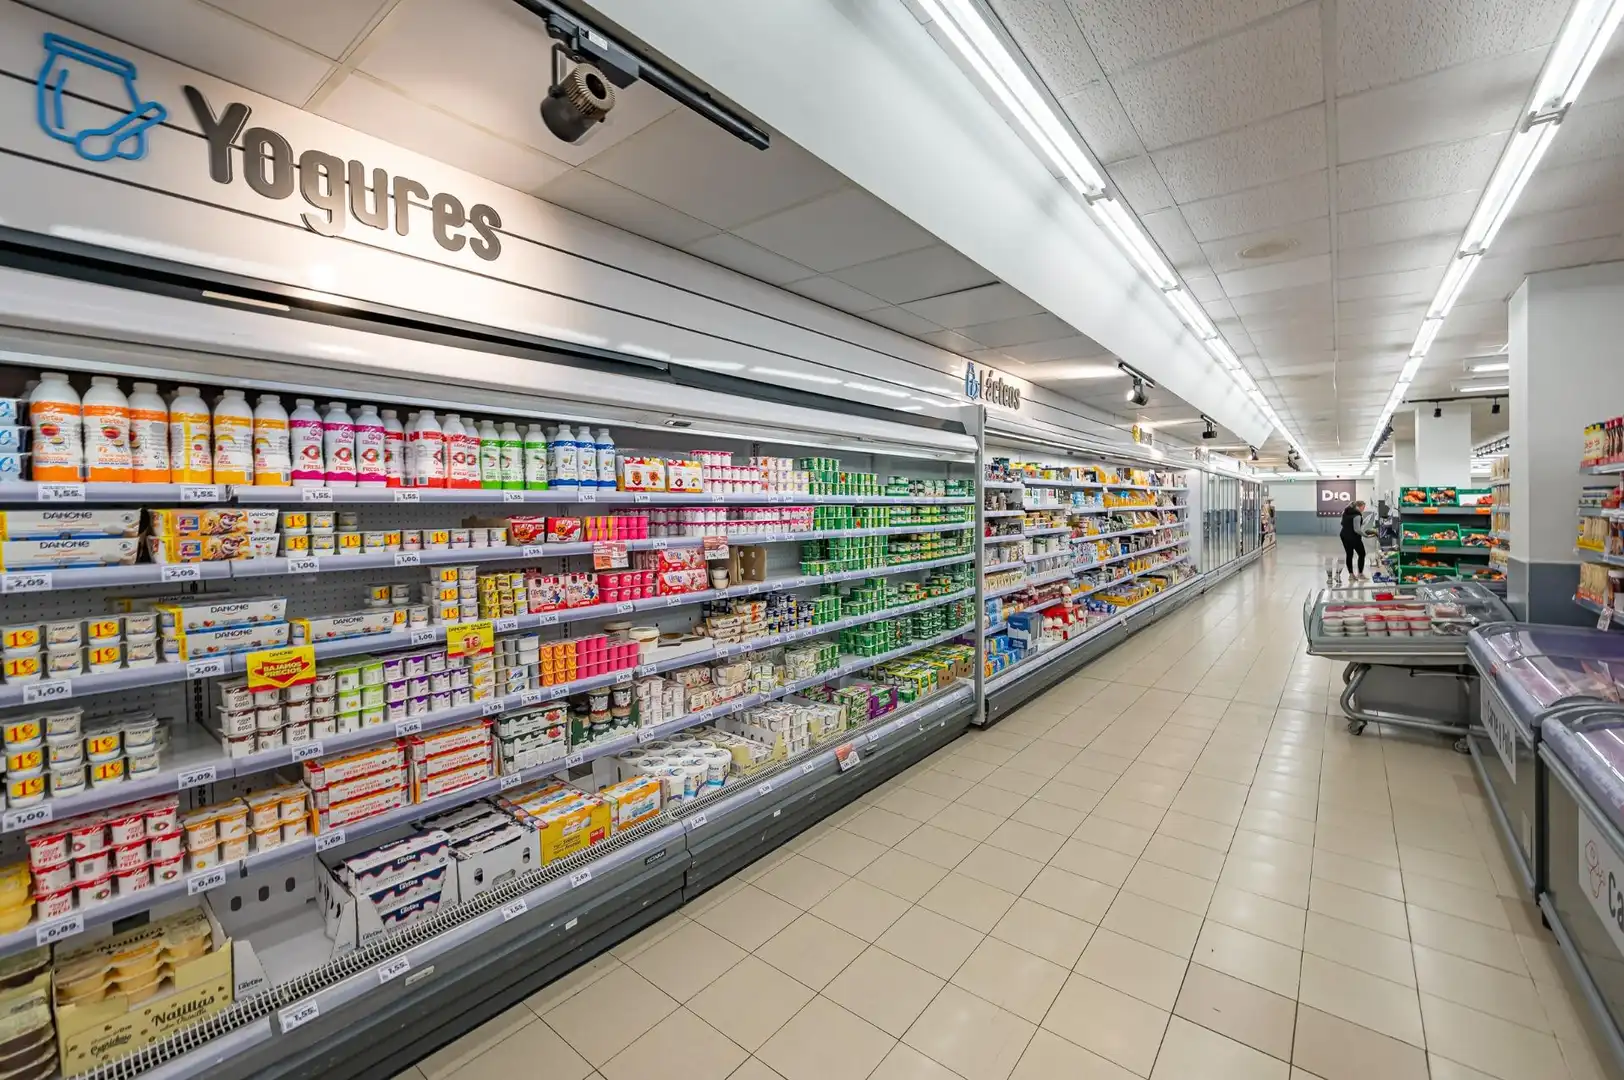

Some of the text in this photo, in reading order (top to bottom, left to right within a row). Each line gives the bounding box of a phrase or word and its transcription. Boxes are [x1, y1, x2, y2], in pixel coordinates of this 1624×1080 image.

[183, 84, 502, 261] Yogures
[980, 370, 1020, 410] Lácteos
[43, 511, 92, 520] DANONE
[39, 541, 90, 550] DANONE
[210, 603, 249, 614] DANONE
[333, 616, 364, 626] DANONE
[215, 629, 253, 640] DANONE
[264, 661, 302, 671] BAJAMOS
[264, 668, 301, 678] PRECIOS
[151, 995, 215, 1027] Natillas
